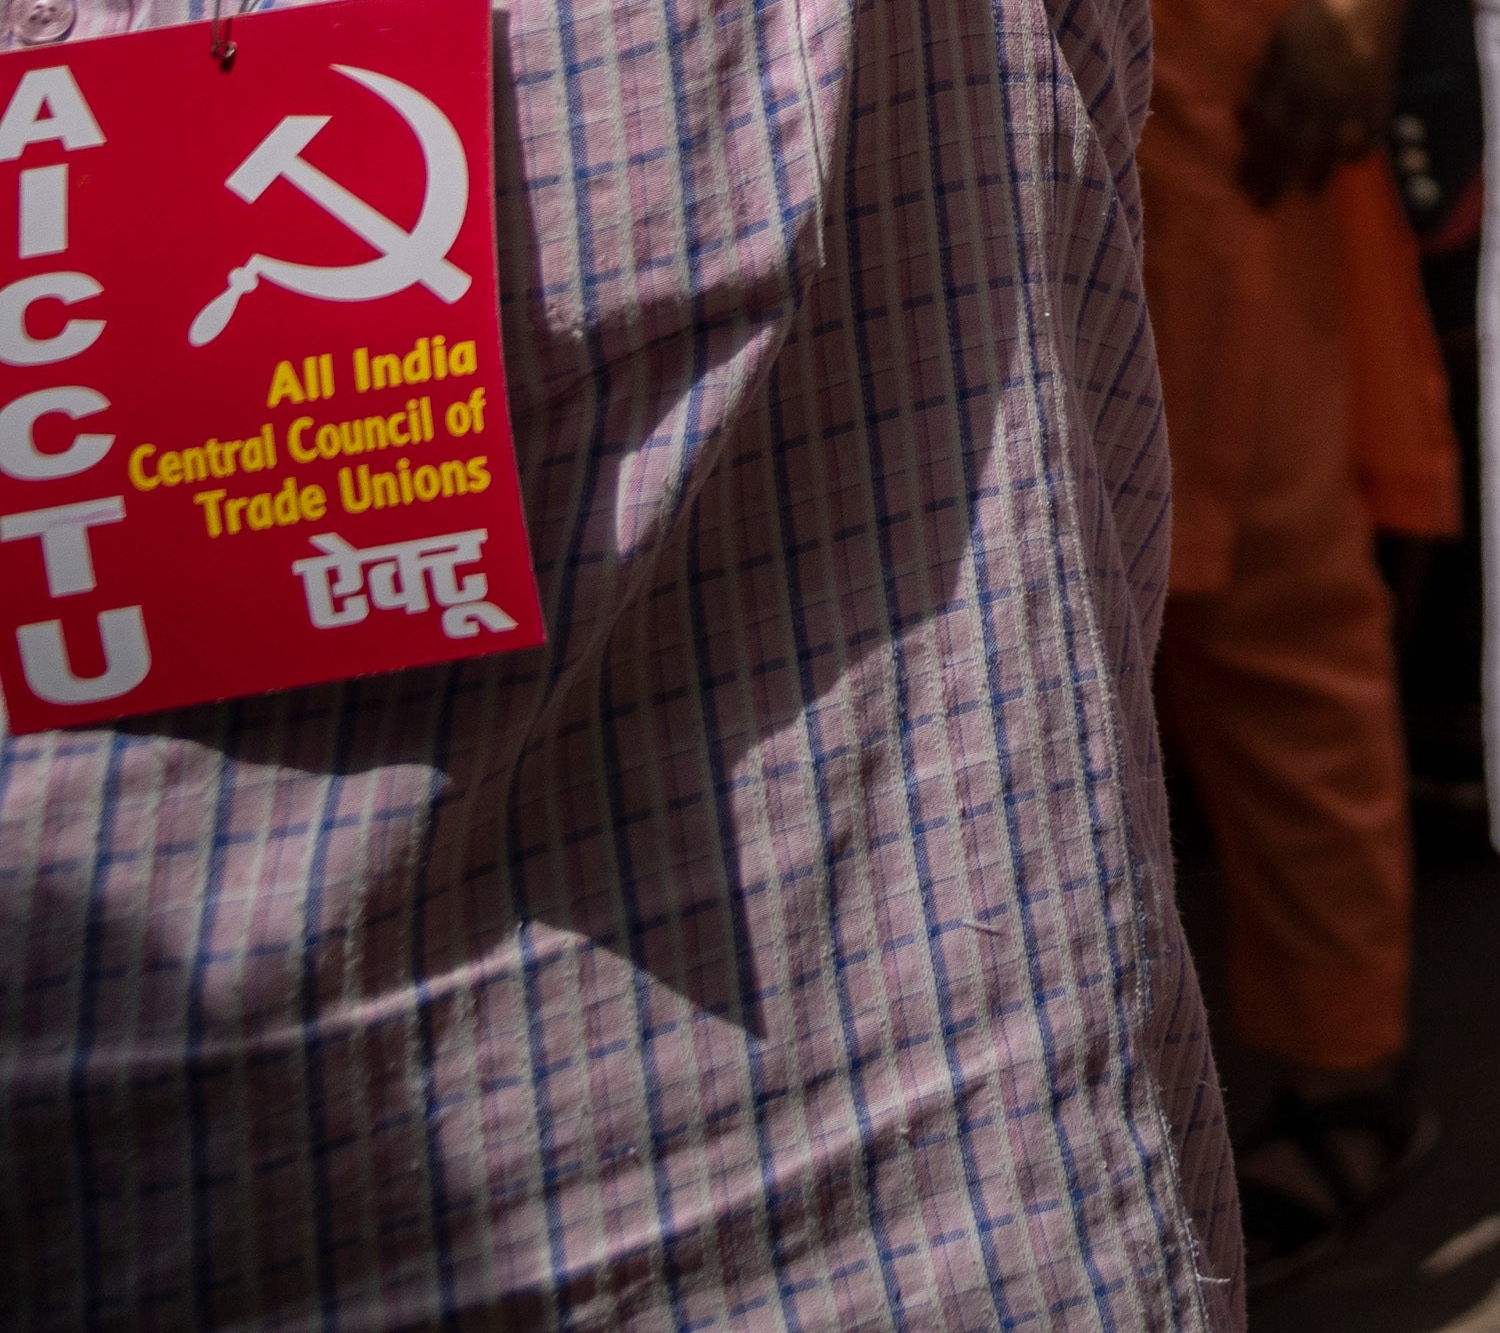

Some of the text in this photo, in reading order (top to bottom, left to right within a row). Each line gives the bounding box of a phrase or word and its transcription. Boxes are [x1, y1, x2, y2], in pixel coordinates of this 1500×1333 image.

[0, 64, 152, 707] AICCTU
[267, 335, 478, 408] All India
[127, 388, 488, 493] Central Council of
[194, 452, 493, 539] Trade Unions
[292, 528, 518, 639] ऐक्टू
